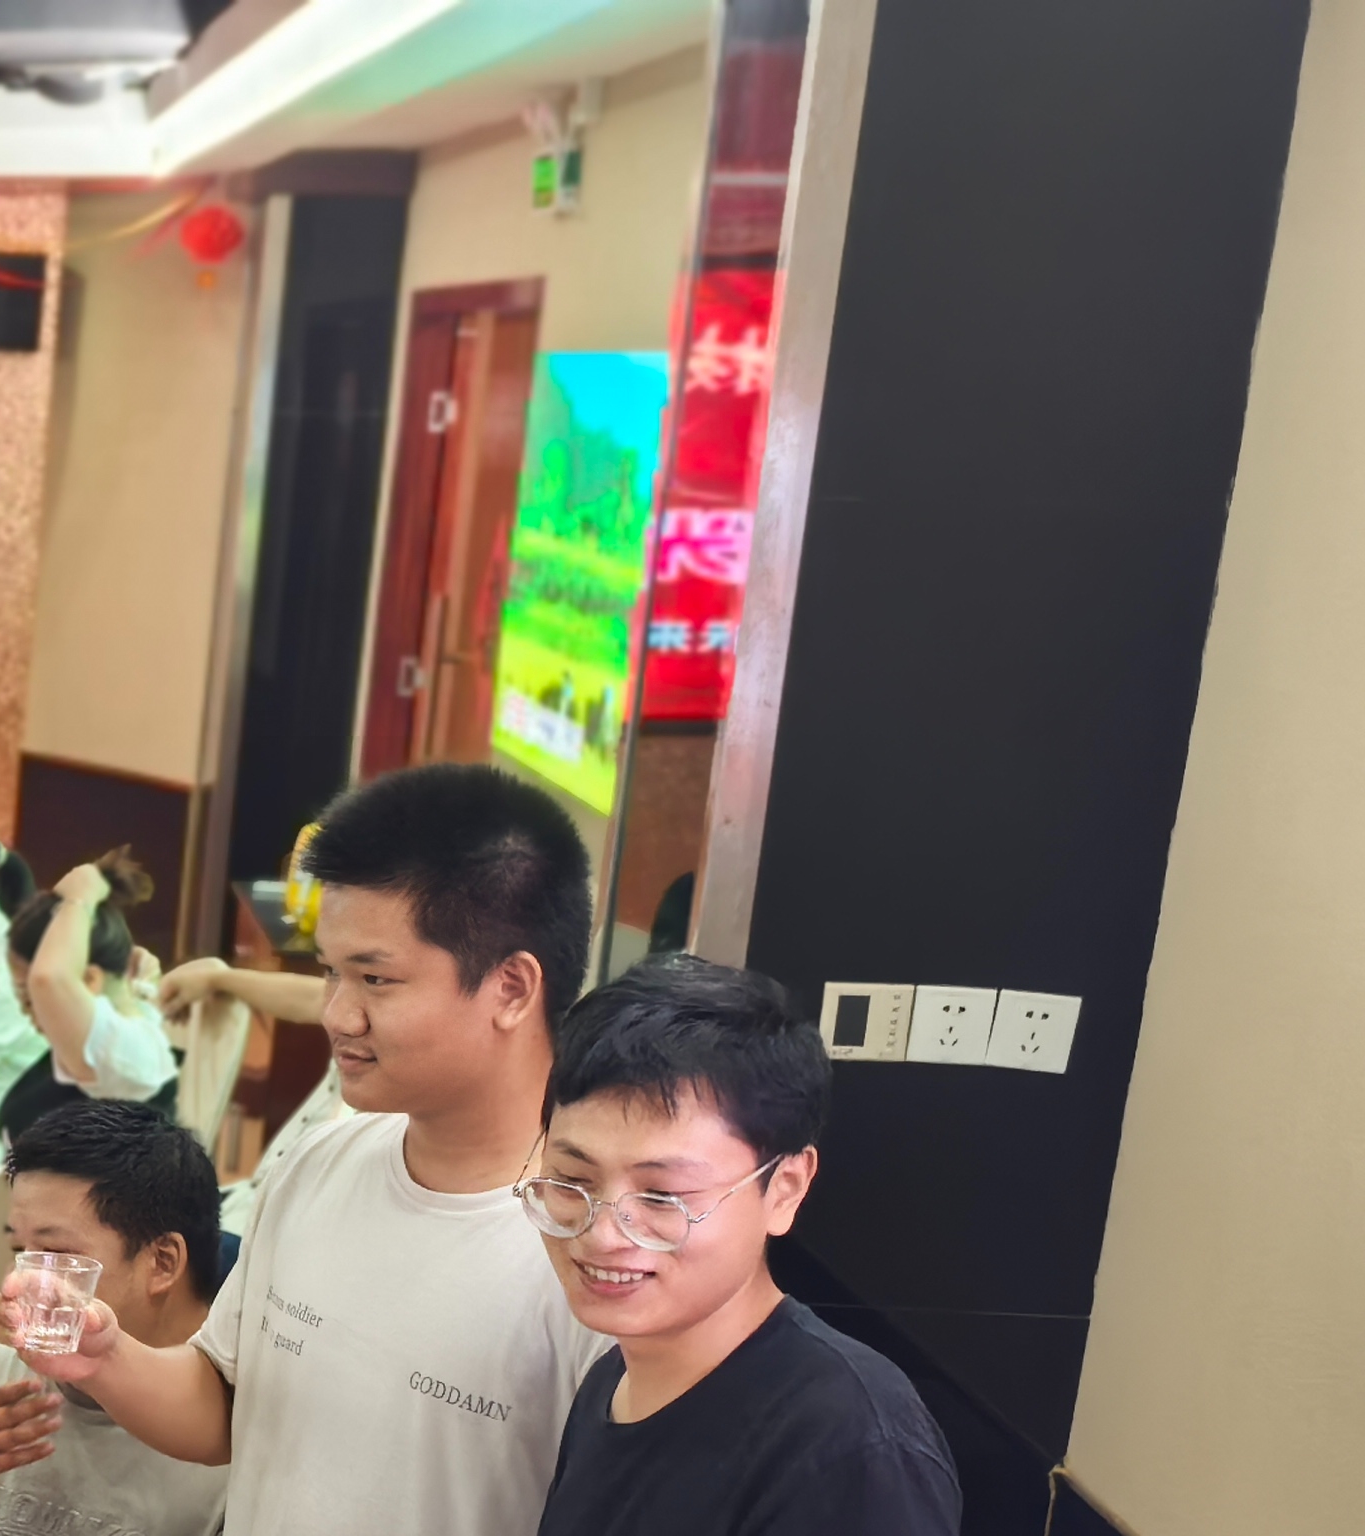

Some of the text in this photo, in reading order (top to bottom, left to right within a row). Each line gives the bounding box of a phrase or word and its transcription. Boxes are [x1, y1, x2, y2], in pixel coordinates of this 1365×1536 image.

[285, 1302, 323, 1328] soldier
[274, 1332, 305, 1356] guard
[409, 1371, 512, 1422] GODDAMN
